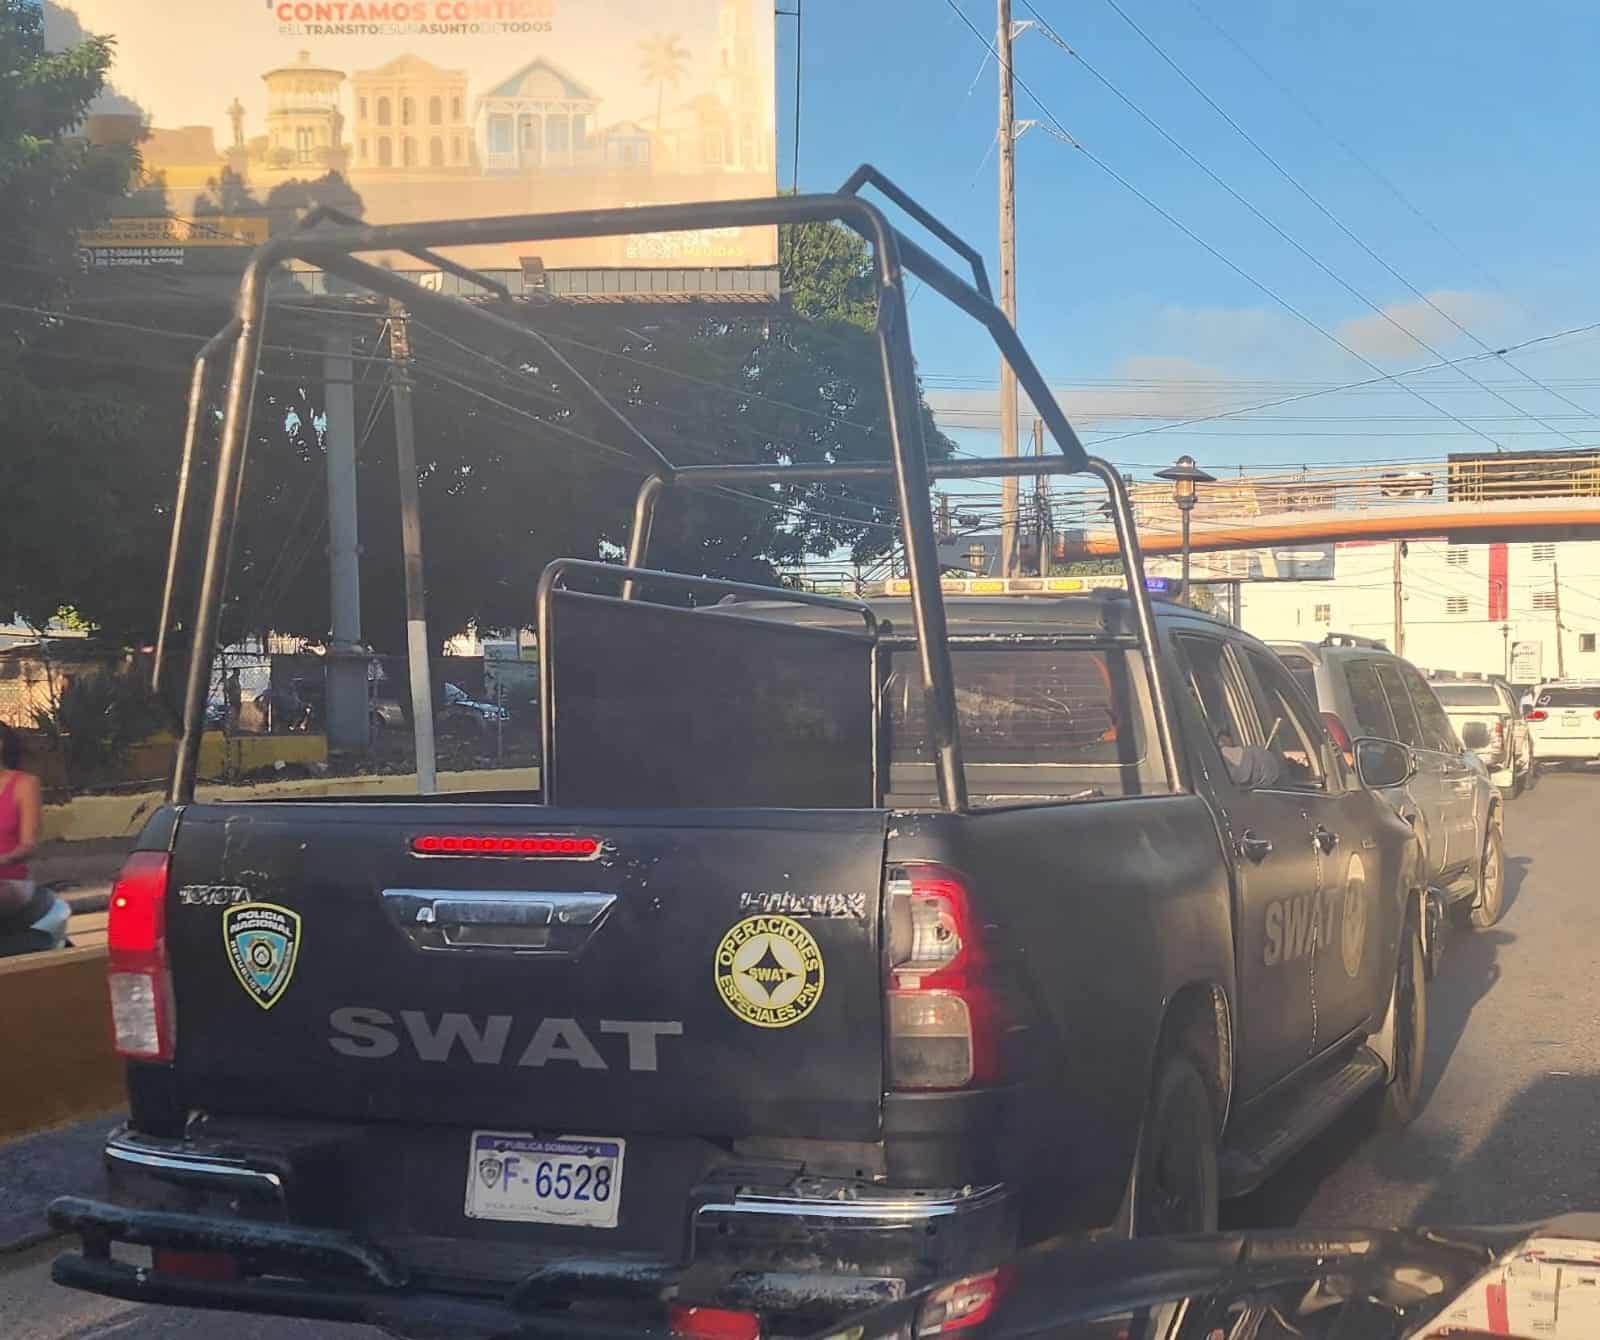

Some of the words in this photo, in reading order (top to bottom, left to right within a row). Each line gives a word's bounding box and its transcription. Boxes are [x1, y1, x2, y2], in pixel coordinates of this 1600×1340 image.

[276, 2, 427, 21] CONTAMOS
[236, 910, 286, 923] POLICIA
[229, 919, 293, 937] NACIONAL
[1263, 887, 1338, 967] SWAT
[719, 918, 819, 972] OPERACIONES
[748, 967, 788, 982] SWAT
[328, 1006, 684, 1072] SWAT
